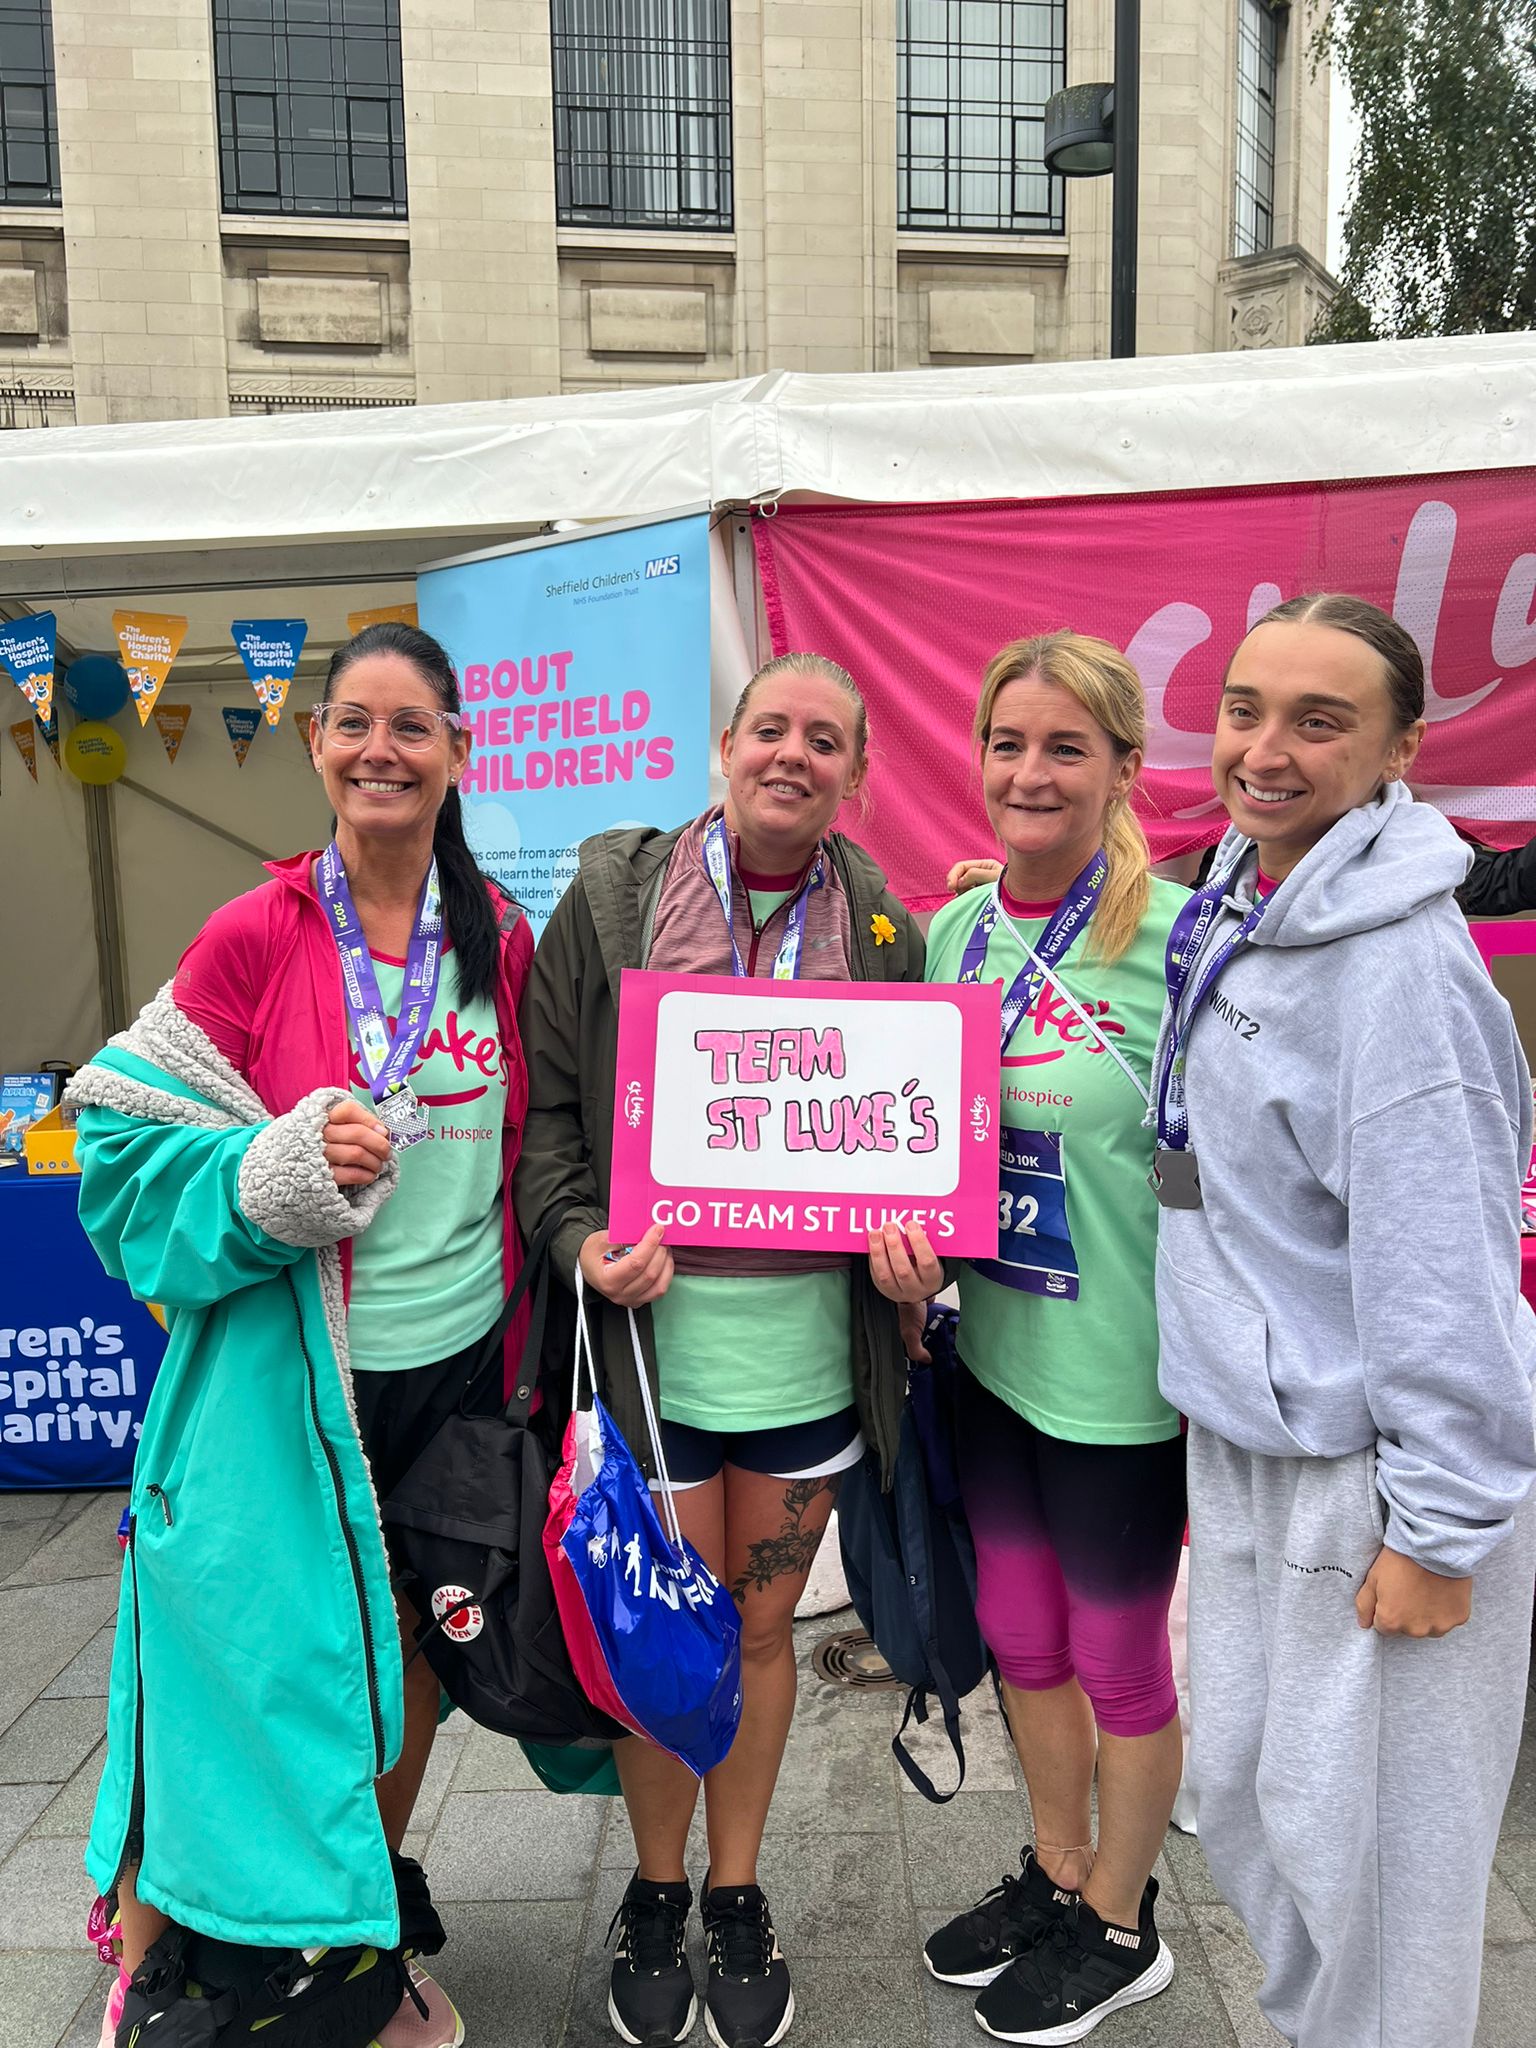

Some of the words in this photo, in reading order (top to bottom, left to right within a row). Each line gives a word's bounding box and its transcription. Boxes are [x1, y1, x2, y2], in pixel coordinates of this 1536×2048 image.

[545, 578, 589, 598] Sheffield
[592, 569, 640, 589] Children's
[646, 556, 679, 578] NHS
[588, 591, 623, 604] Foundation
[624, 587, 639, 596] Trust
[0, 636, 45, 655] Children's
[119, 632, 170, 645] Children's
[128, 641, 171, 653] Hospital
[240, 641, 291, 649] Children's
[8, 643, 49, 661] Hospital
[249, 649, 293, 659] Hospital
[452, 650, 574, 703] BOUT
[486, 850, 516, 860] come
[518, 847, 546, 859] from
[500, 868, 528, 880] learn
[531, 866, 550, 879] the
[1088, 865, 1106, 890] 2024
[333, 901, 348, 928] 2024
[1048, 930, 1066, 954] RUN
[1062, 911, 1080, 932] FOR
[1076, 895, 1092, 912] ALL
[1182, 920, 1207, 967] SHEFFIELD
[1202, 901, 1212, 919] 10K
[340, 952, 356, 992] SHEFFIELD
[694, 1026, 846, 1084] TEAM
[1006, 1086, 1073, 1107] Hospice
[706, 1096, 771, 1152] ST
[784, 1078, 939, 1155] LUKE'S
[441, 1125, 493, 1143] Hospice
[1016, 1154, 1040, 1168] 10K
[651, 1200, 701, 1227] GO
[708, 1202, 794, 1231] TEAM
[803, 1206, 841, 1232] ST
[1104, 1928, 1141, 1950] PUMA
